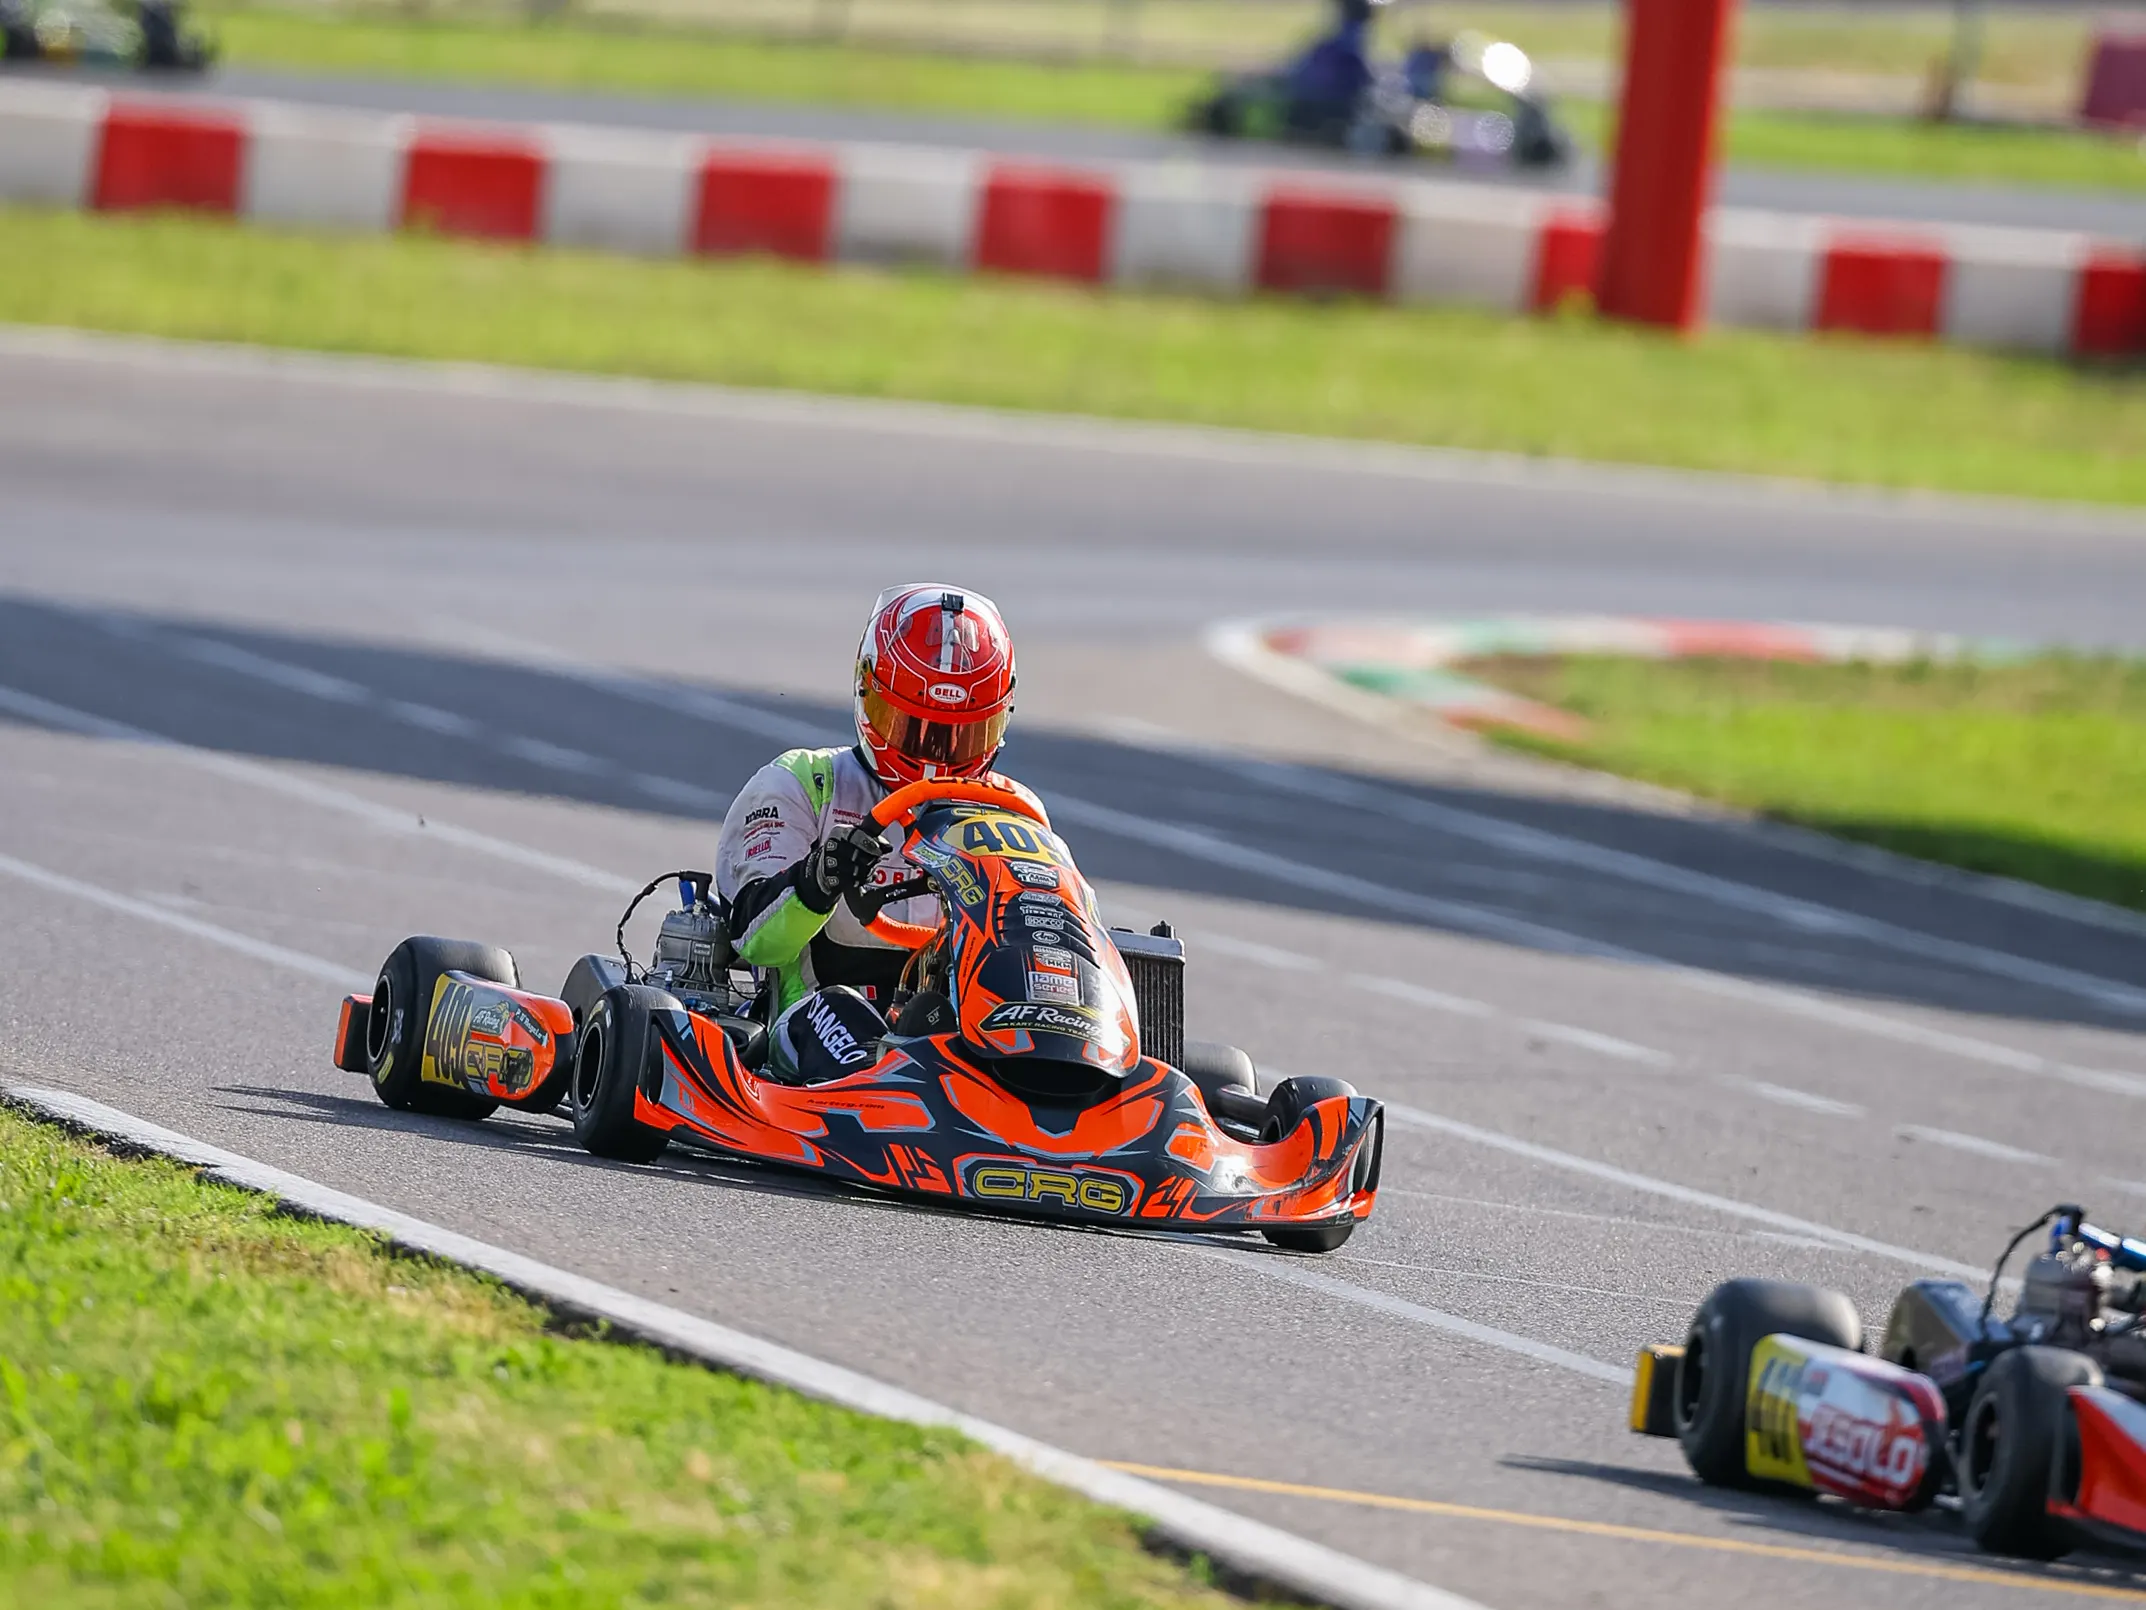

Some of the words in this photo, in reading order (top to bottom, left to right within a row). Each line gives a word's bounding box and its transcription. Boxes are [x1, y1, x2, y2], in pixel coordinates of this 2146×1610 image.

[935, 687, 962, 698] BELL
[940, 857, 985, 906] CRG
[1033, 983, 1075, 996] series
[992, 1005, 1038, 1022] AF
[1036, 1007, 1101, 1036] Racing
[1034, 1023, 1066, 1032] RACING
[974, 1167, 1125, 1214] CRG
